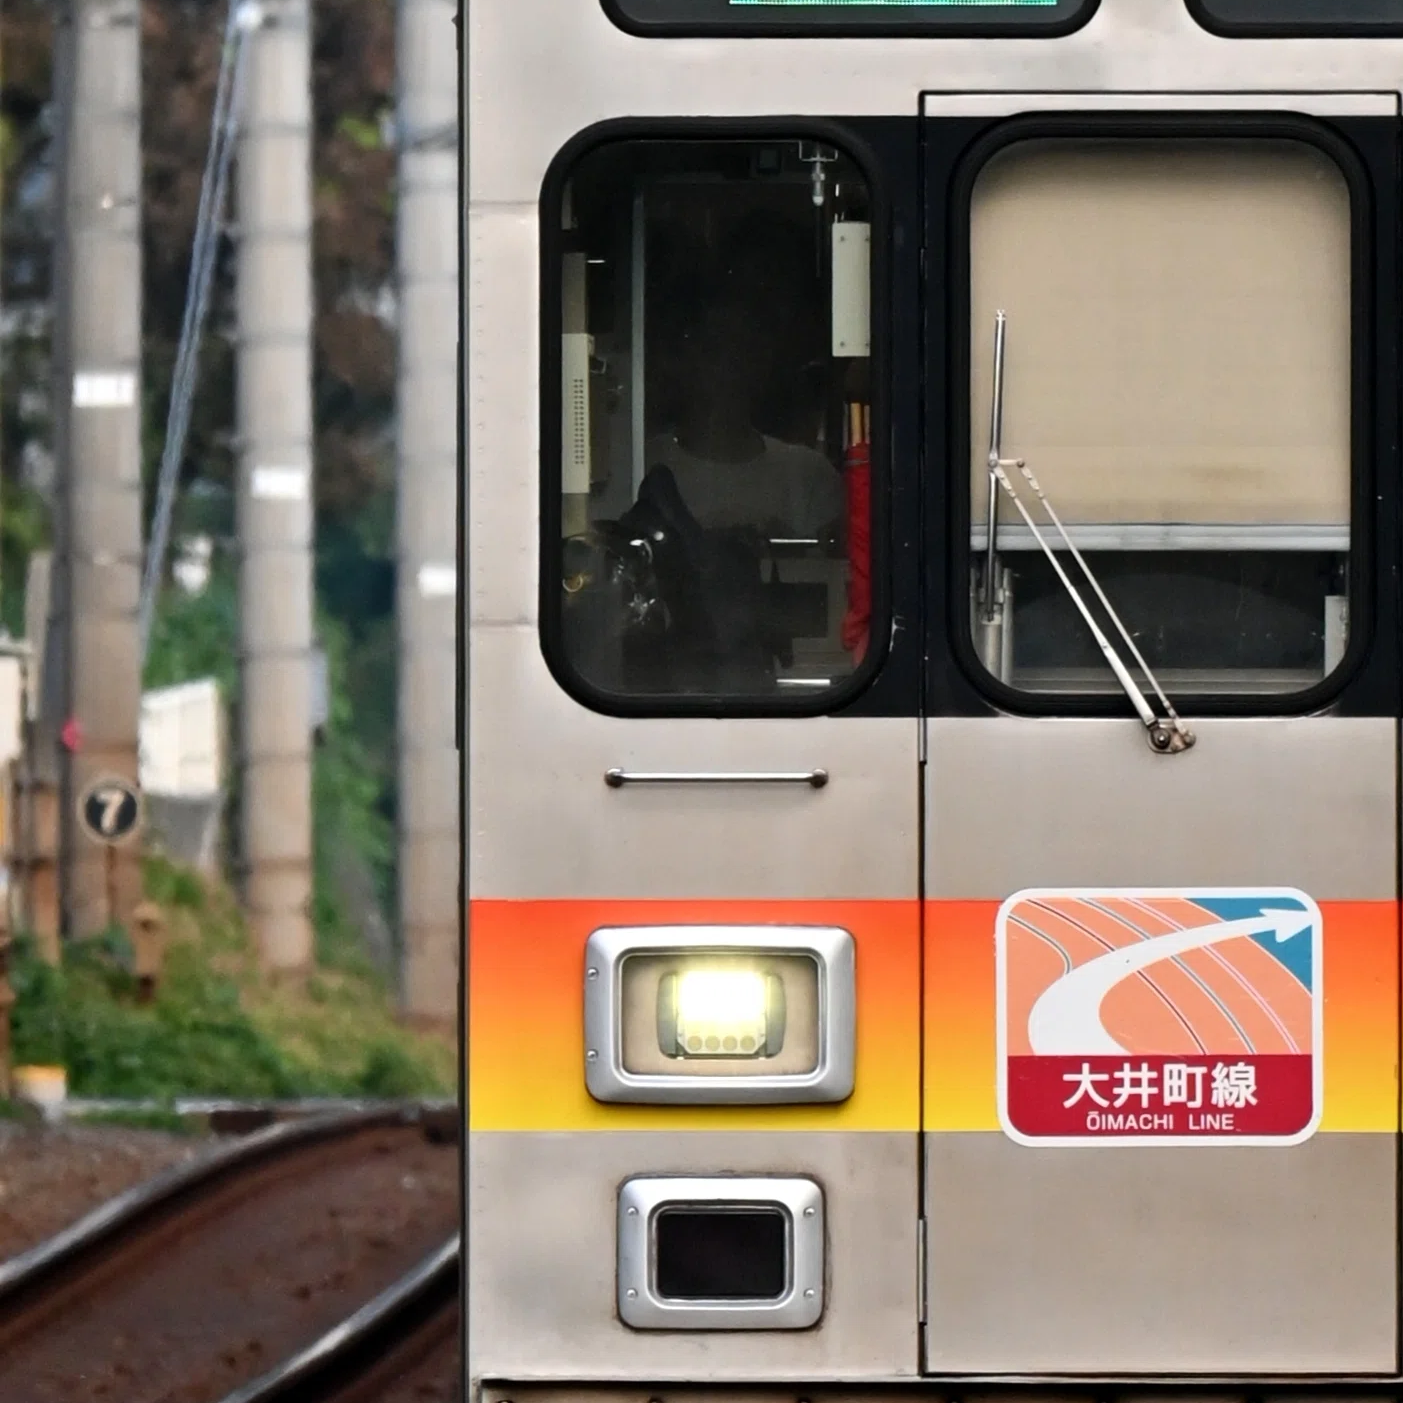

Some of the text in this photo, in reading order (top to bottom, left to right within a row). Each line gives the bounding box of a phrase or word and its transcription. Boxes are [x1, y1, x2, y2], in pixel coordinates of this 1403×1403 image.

[1062, 1061, 1258, 1109] 大井町線
[1188, 1113, 1235, 1130] LINE
